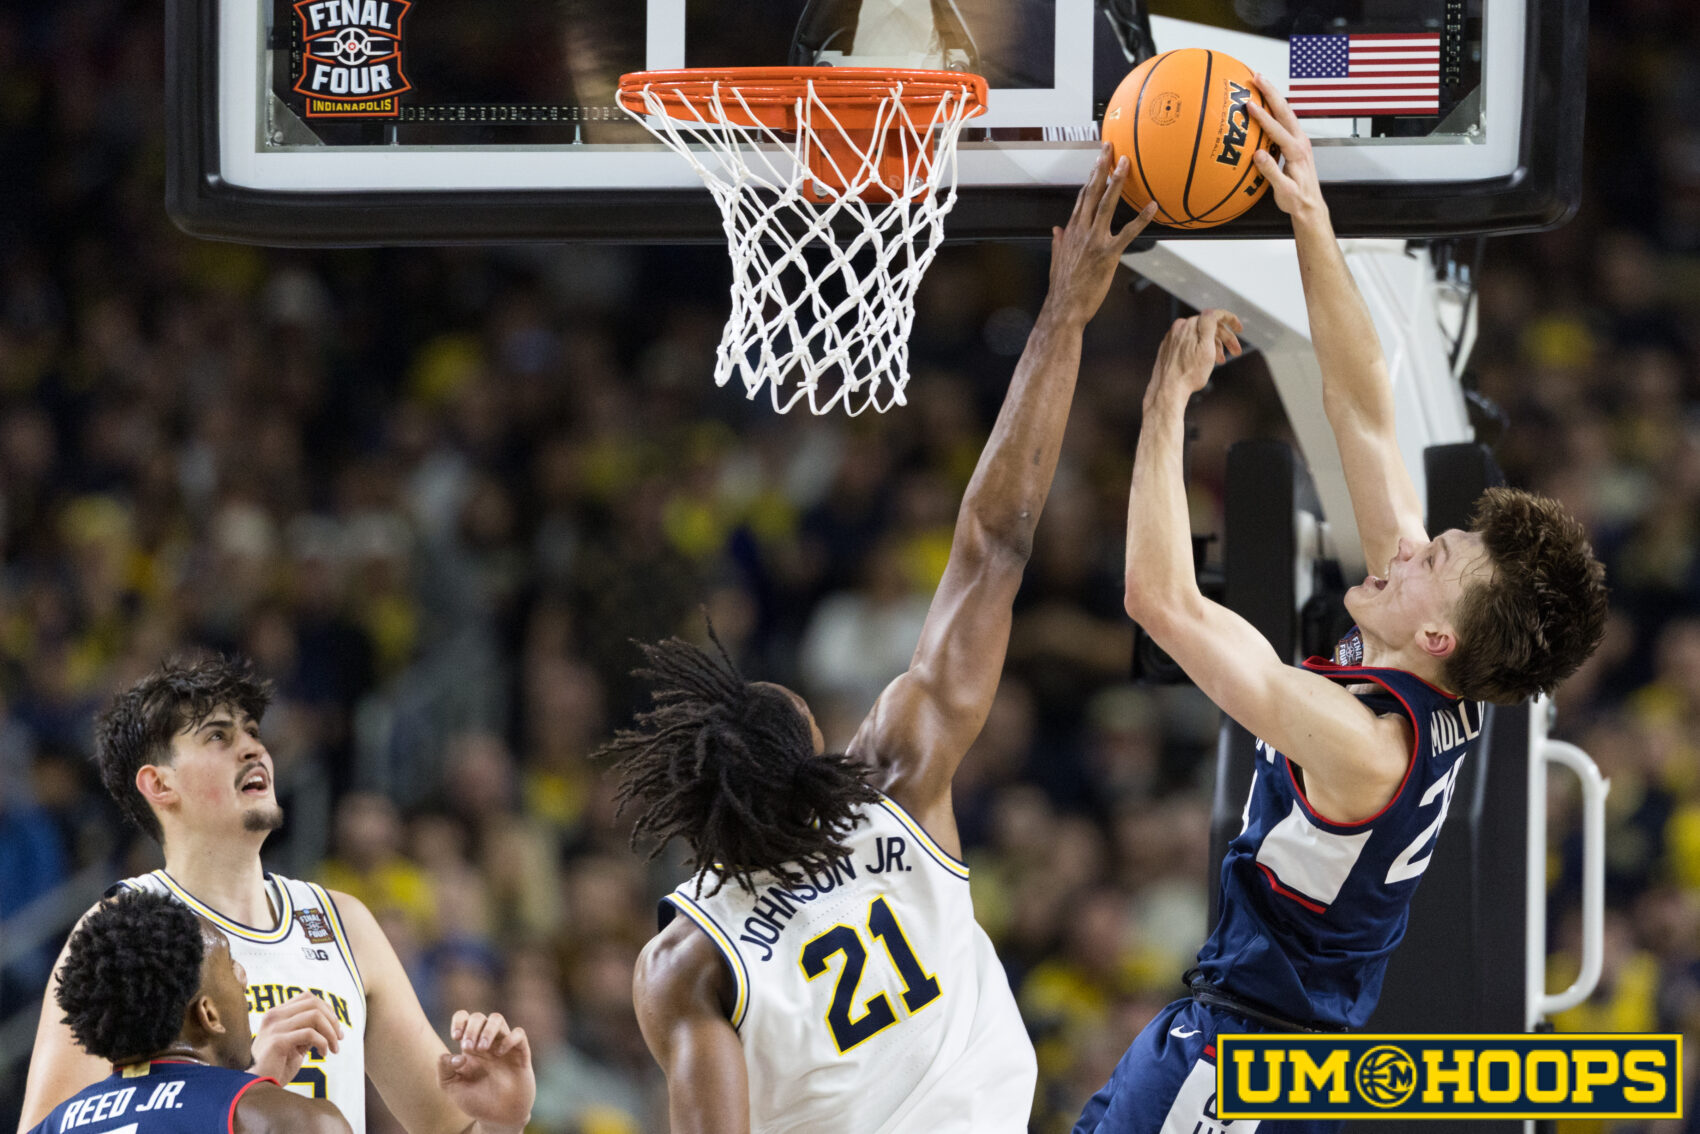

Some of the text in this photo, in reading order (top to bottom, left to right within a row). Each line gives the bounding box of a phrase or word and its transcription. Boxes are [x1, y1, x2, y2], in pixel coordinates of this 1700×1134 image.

[308, 0, 392, 31] FINAL
[311, 64, 393, 94] FOUR
[313, 98, 392, 112] INDIANAPOLIS
[1216, 79, 1252, 167] NCAA
[1339, 644, 1348, 666] FOUR
[1352, 636, 1363, 662] FINAL
[740, 836, 912, 962] JOHNSON JR.
[299, 914, 322, 924] FINAL
[307, 929, 329, 938] FOUR
[798, 894, 943, 1056] 21
[59, 1080, 186, 1134] REED JR.
